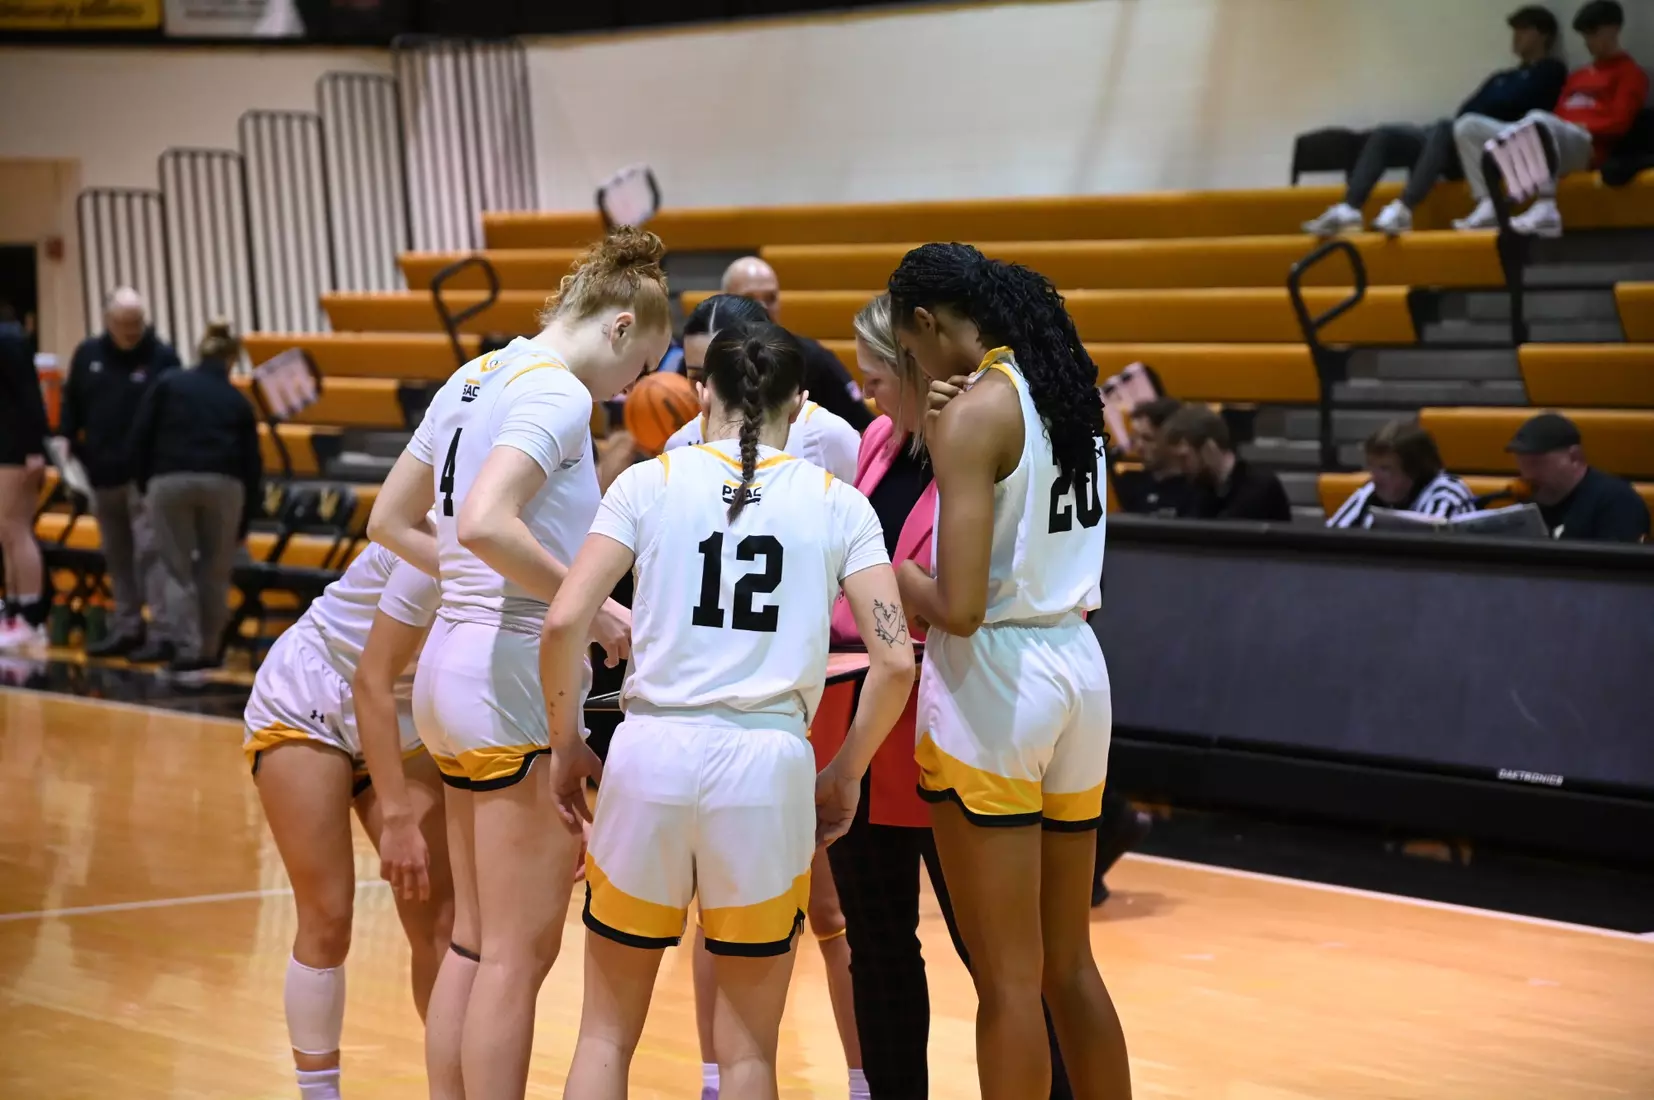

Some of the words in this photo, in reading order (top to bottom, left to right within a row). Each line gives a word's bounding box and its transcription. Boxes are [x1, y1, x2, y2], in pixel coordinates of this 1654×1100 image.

[440, 428, 462, 516] 4
[1048, 446, 1103, 534] 20
[692, 531, 783, 632] 12
